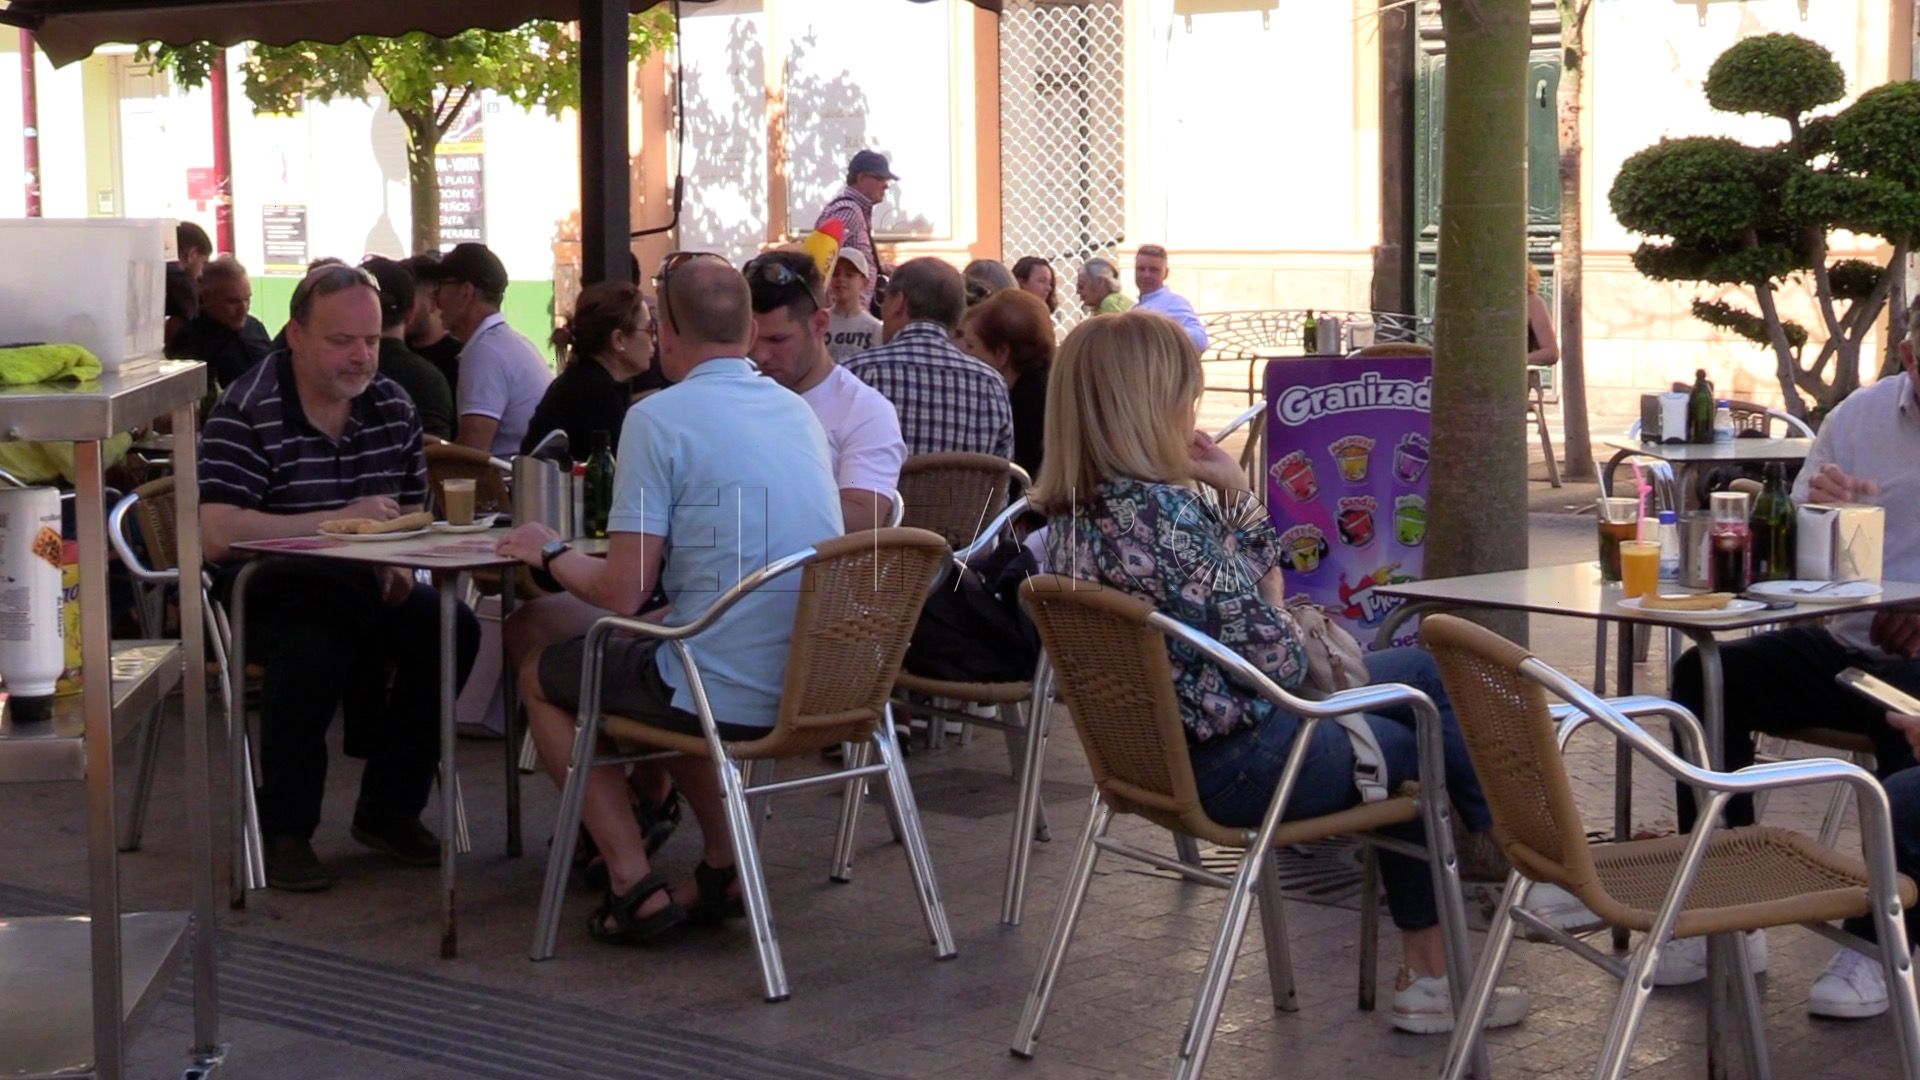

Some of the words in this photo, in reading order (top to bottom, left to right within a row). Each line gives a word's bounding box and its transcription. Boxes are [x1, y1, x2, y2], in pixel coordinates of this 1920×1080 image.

[445, 175, 474, 185] PLATA
[462, 189, 475, 199] DE
[439, 201, 471, 212] PEÑOS
[440, 229, 481, 239] PERABLE
[835, 332, 873, 350] GUTS
[1278, 373, 1432, 425] Granizad
